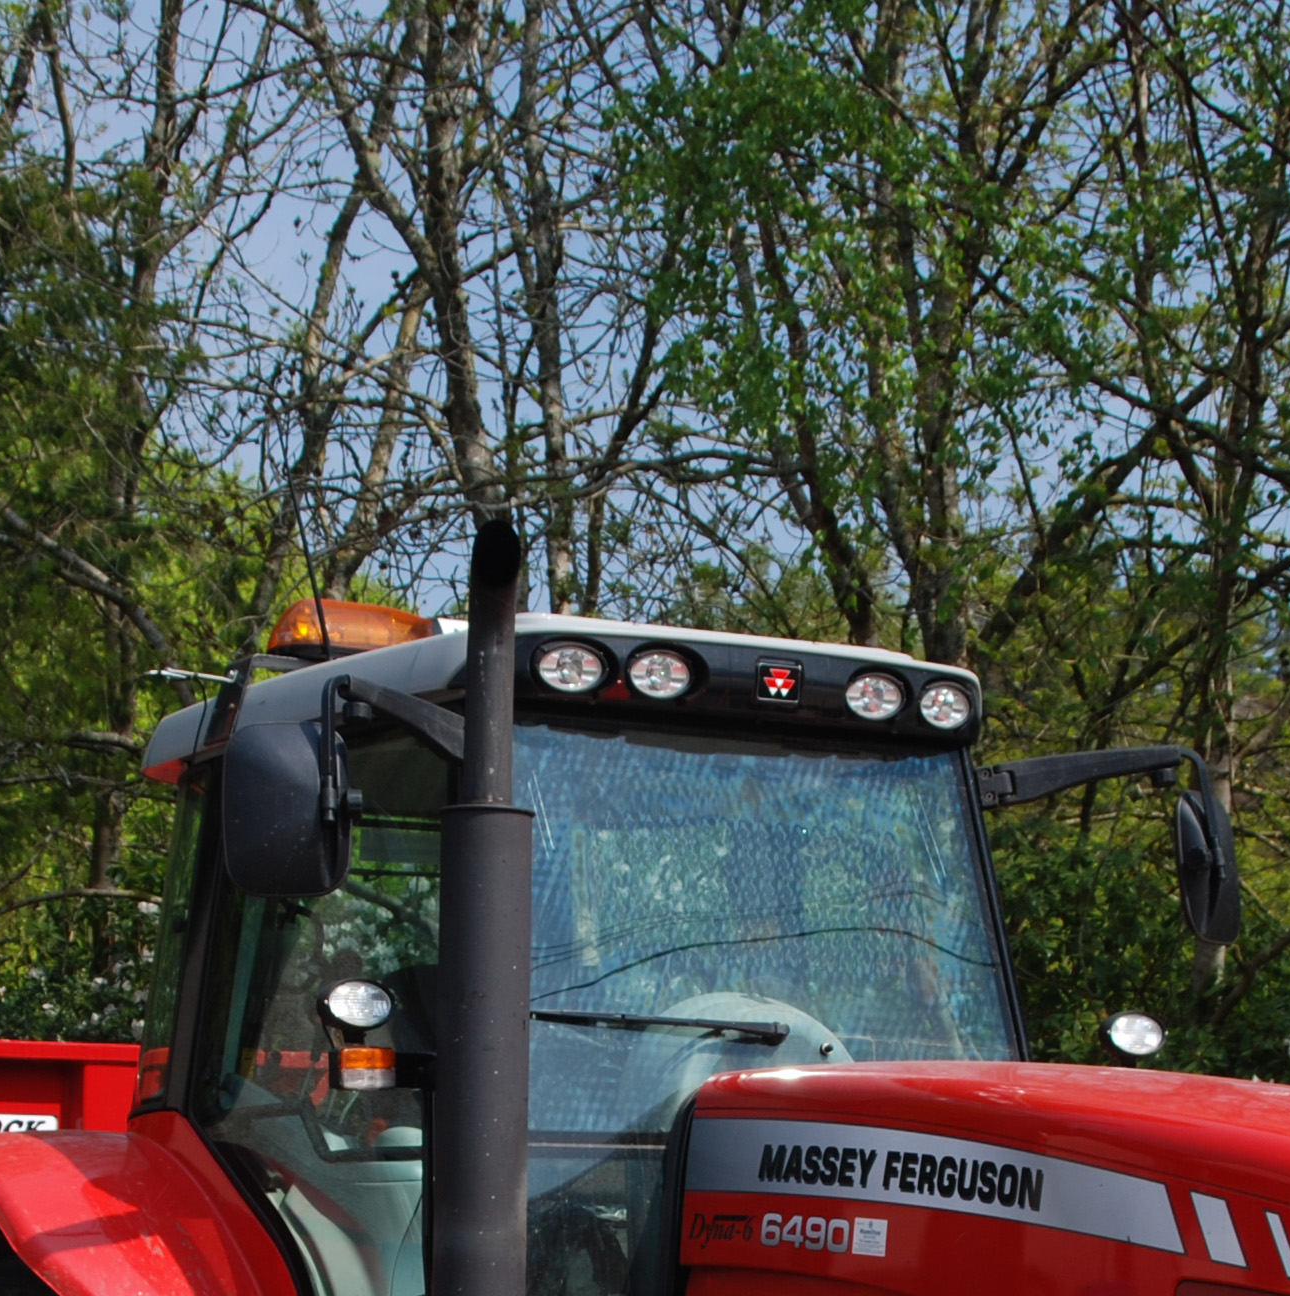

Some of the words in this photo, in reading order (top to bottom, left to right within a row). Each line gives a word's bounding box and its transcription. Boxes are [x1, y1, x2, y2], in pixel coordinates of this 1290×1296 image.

[757, 1144, 878, 1189] MASSEY
[882, 1150, 1045, 1213] FERGUSON
[760, 1212, 851, 1254] 6490
